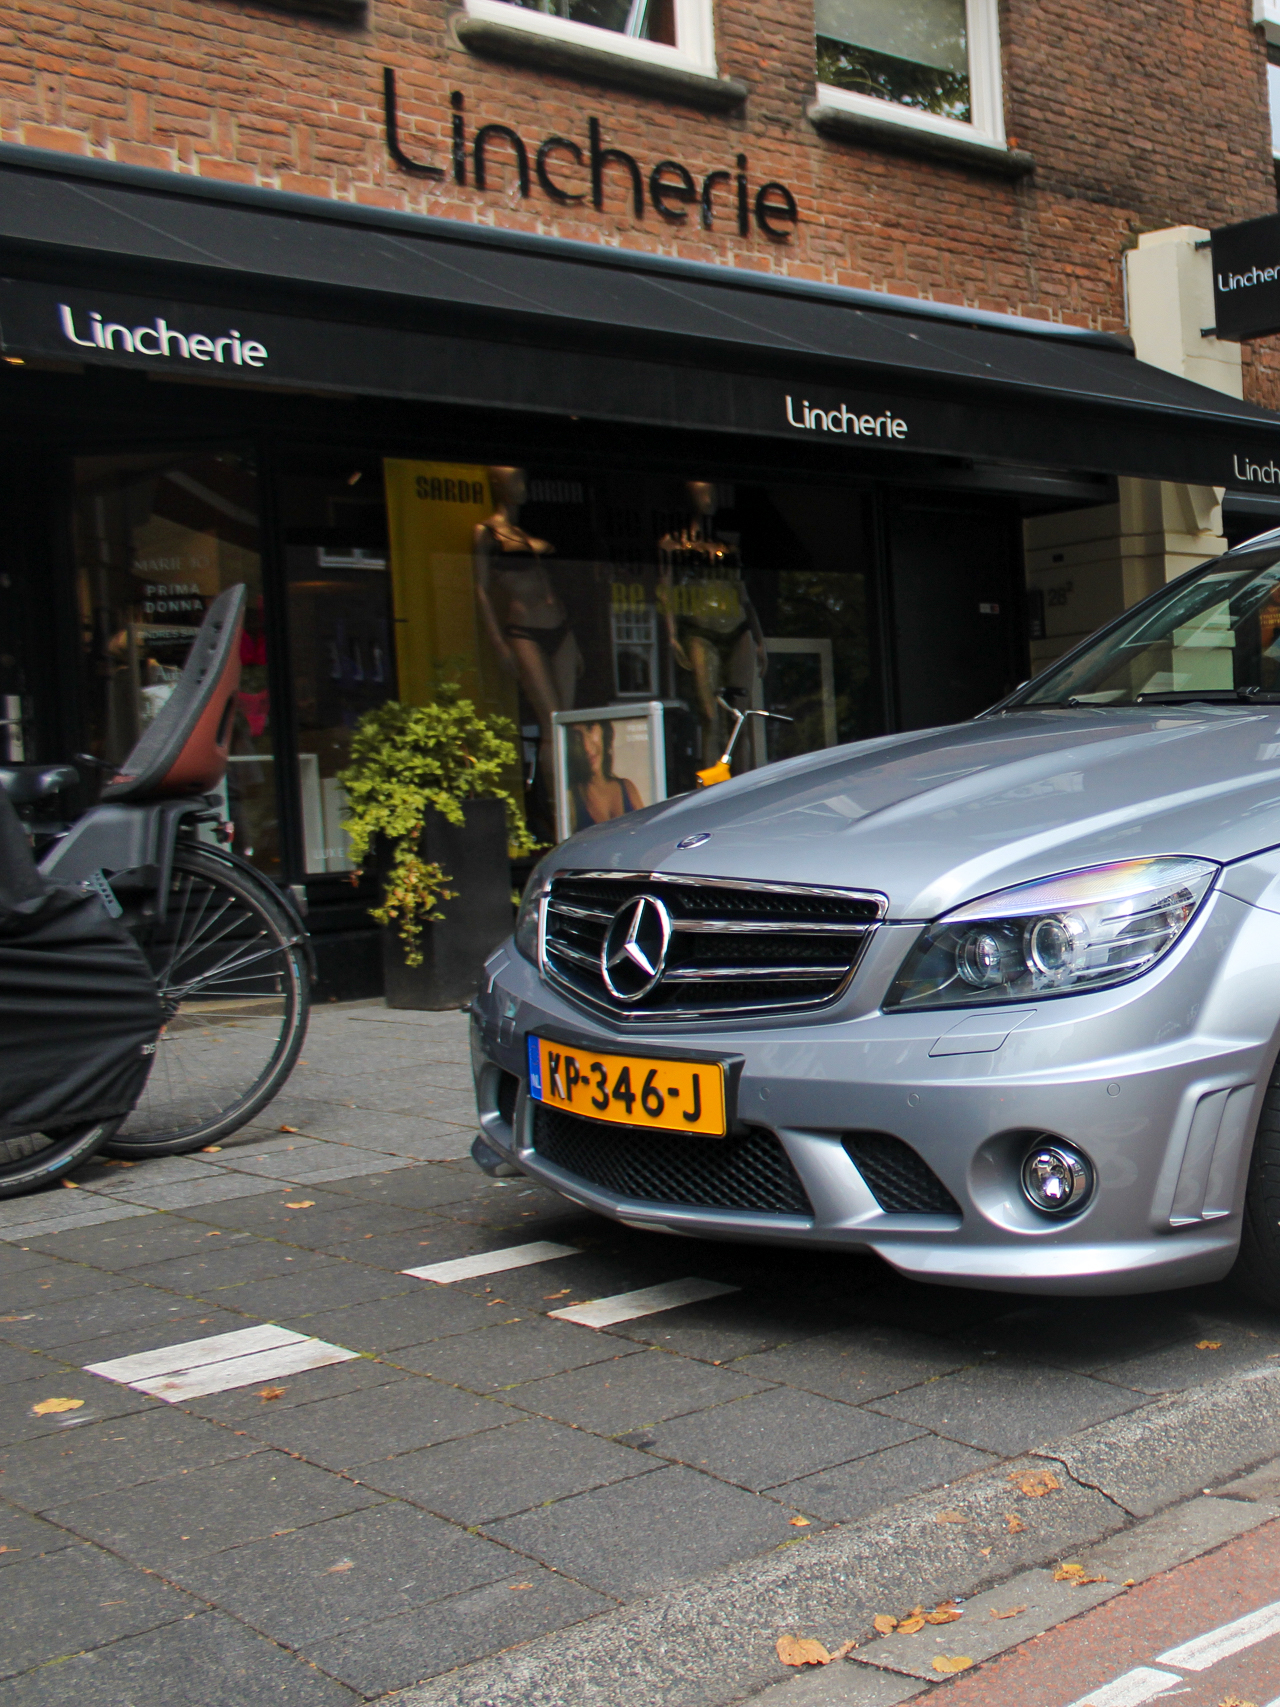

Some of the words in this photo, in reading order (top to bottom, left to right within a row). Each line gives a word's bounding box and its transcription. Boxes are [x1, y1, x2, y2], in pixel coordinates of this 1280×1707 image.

[383, 66, 800, 241] Lincherie
[58, 303, 269, 369] Lincherie
[785, 394, 909, 440] Lincherie
[415, 476, 484, 504] SARDA
[528, 478, 584, 504] ARDA
[144, 599, 203, 614] DONNA
[145, 583, 200, 597] PRIMA
[548, 1050, 702, 1122] KP-346-J
